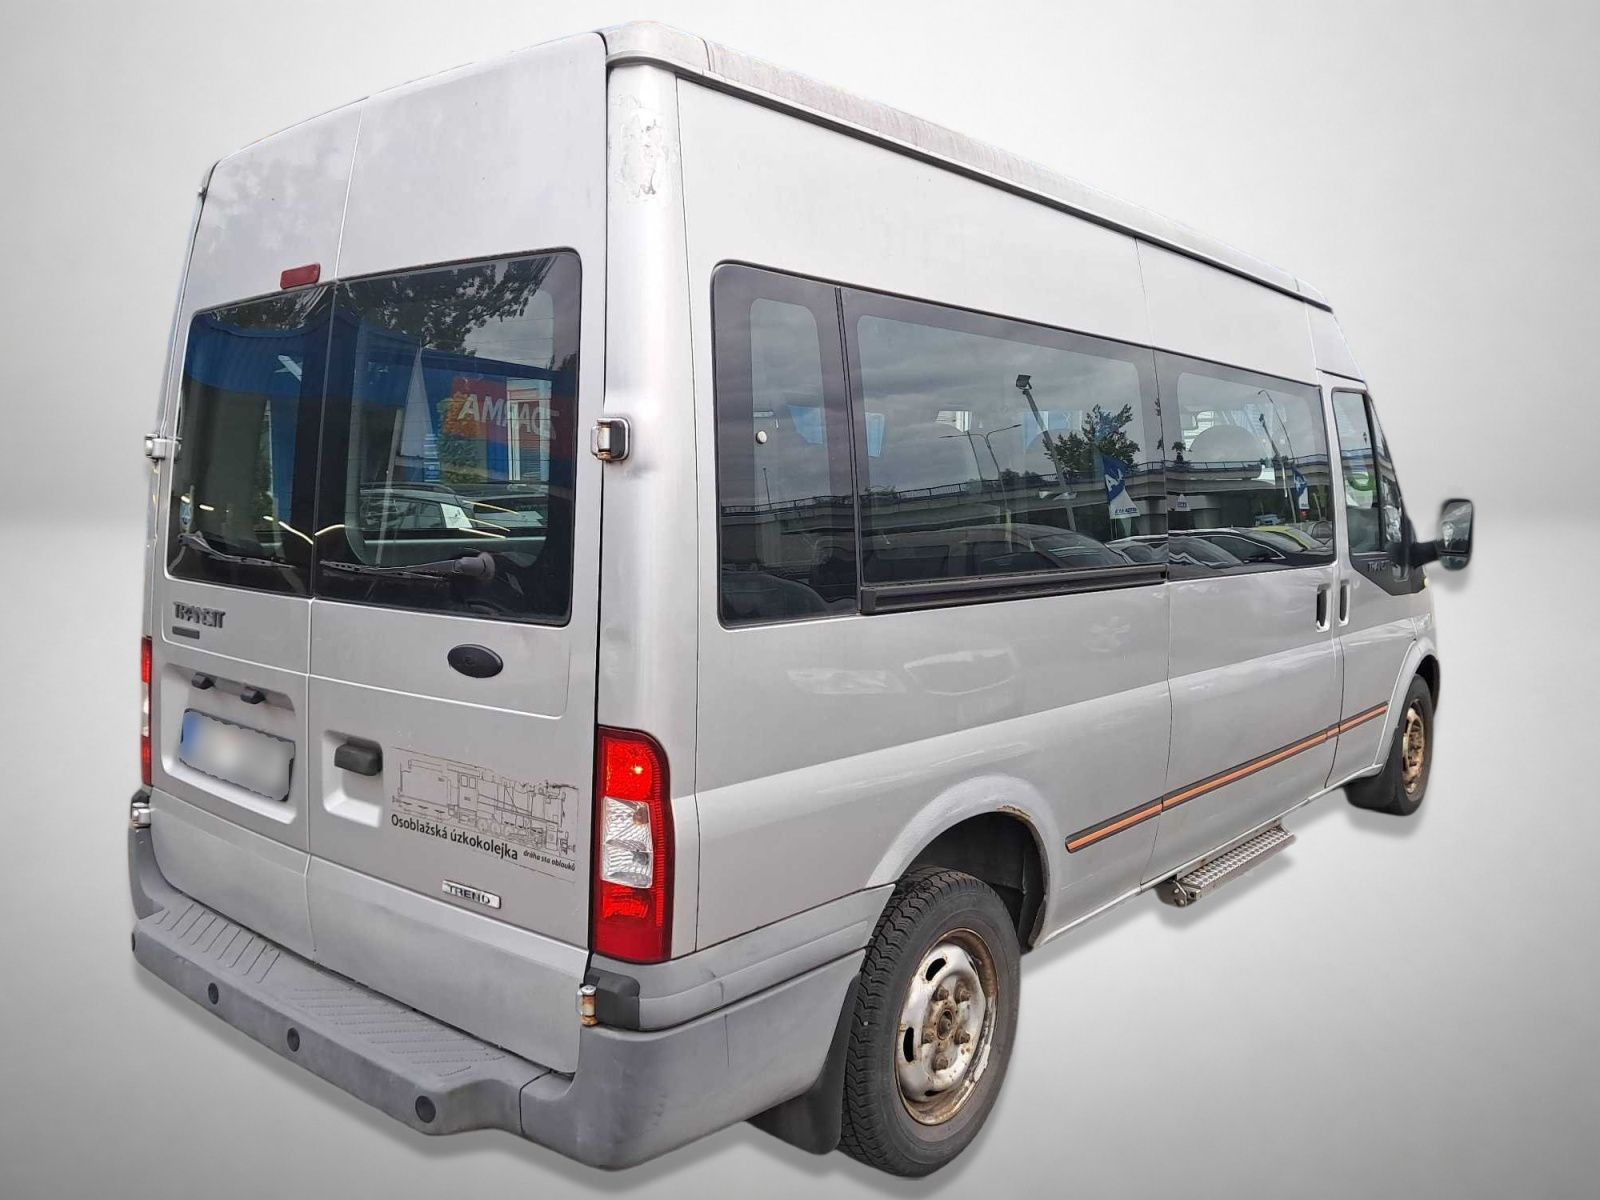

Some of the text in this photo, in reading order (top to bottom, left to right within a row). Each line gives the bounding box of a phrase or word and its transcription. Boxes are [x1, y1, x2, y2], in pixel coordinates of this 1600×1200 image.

[173, 601, 226, 629] TRANSIT
[391, 814, 448, 839] Osoblažská
[450, 829, 518, 860] úzkokolejka
[446, 883, 491, 905] TREND
